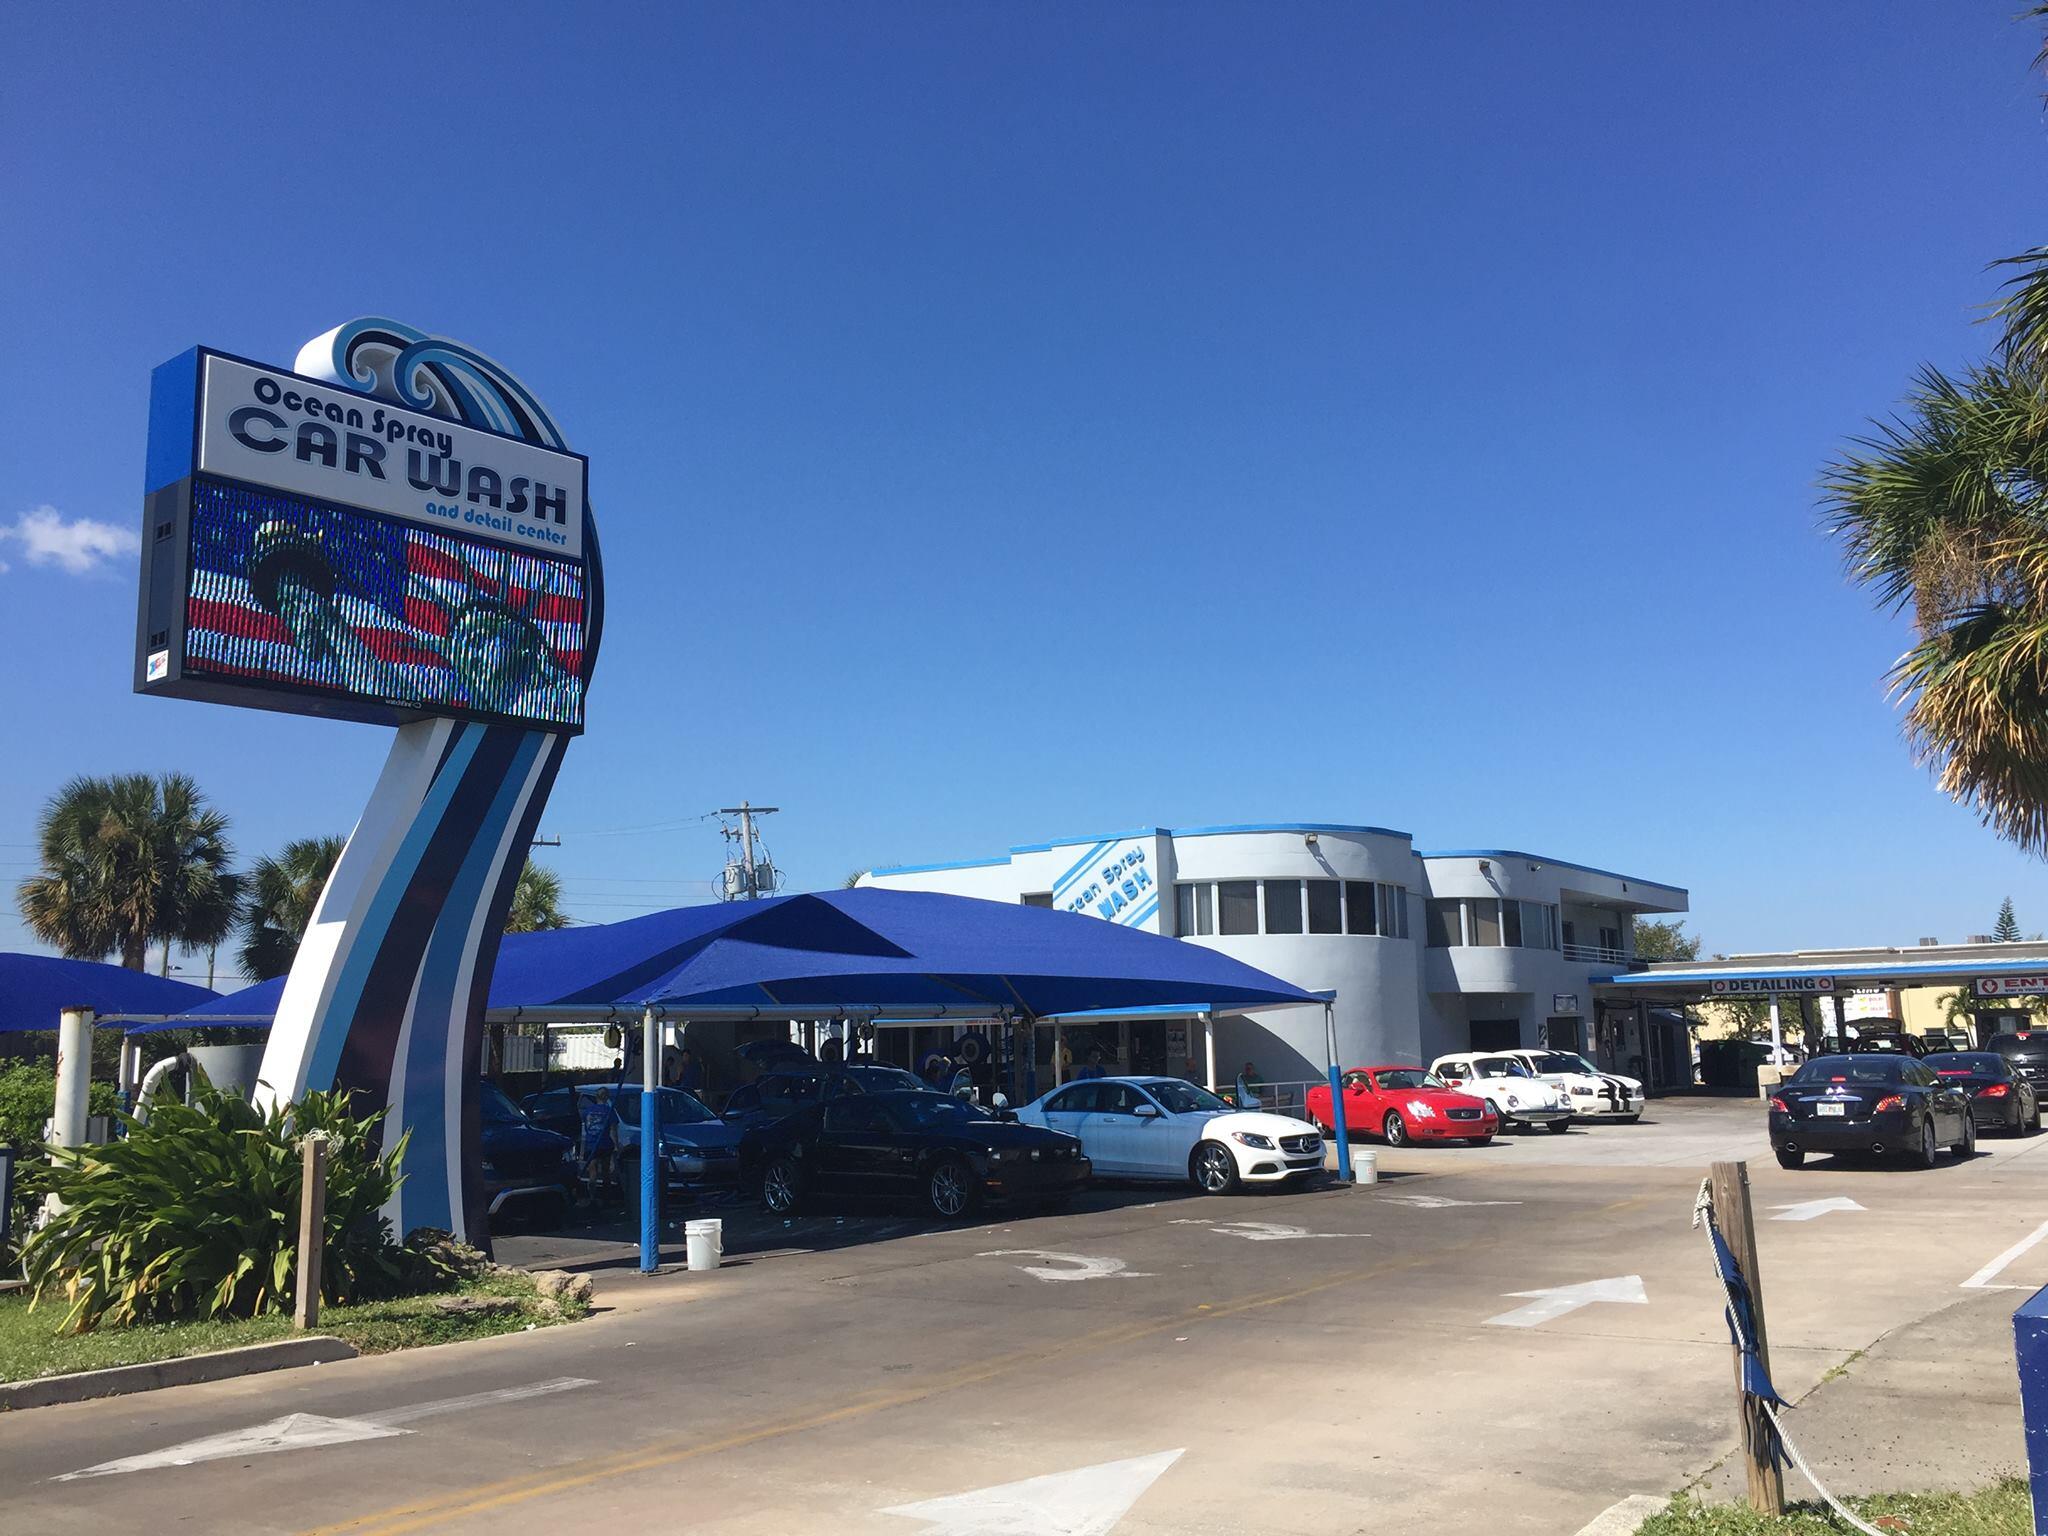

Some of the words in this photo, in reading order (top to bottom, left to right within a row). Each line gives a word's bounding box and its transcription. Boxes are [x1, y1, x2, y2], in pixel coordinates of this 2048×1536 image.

[254, 377, 363, 429] Ocean
[372, 409, 452, 459] Spray
[227, 406, 388, 481] CAR
[407, 447, 567, 526] WASH
[426, 502, 459, 519] and
[464, 508, 512, 532] detail
[516, 523, 567, 546] center
[1068, 883, 1102, 913] cean
[1102, 845, 1145, 886] Spray
[1097, 866, 1153, 921] WASH
[1729, 978, 1816, 991] DETAILING
